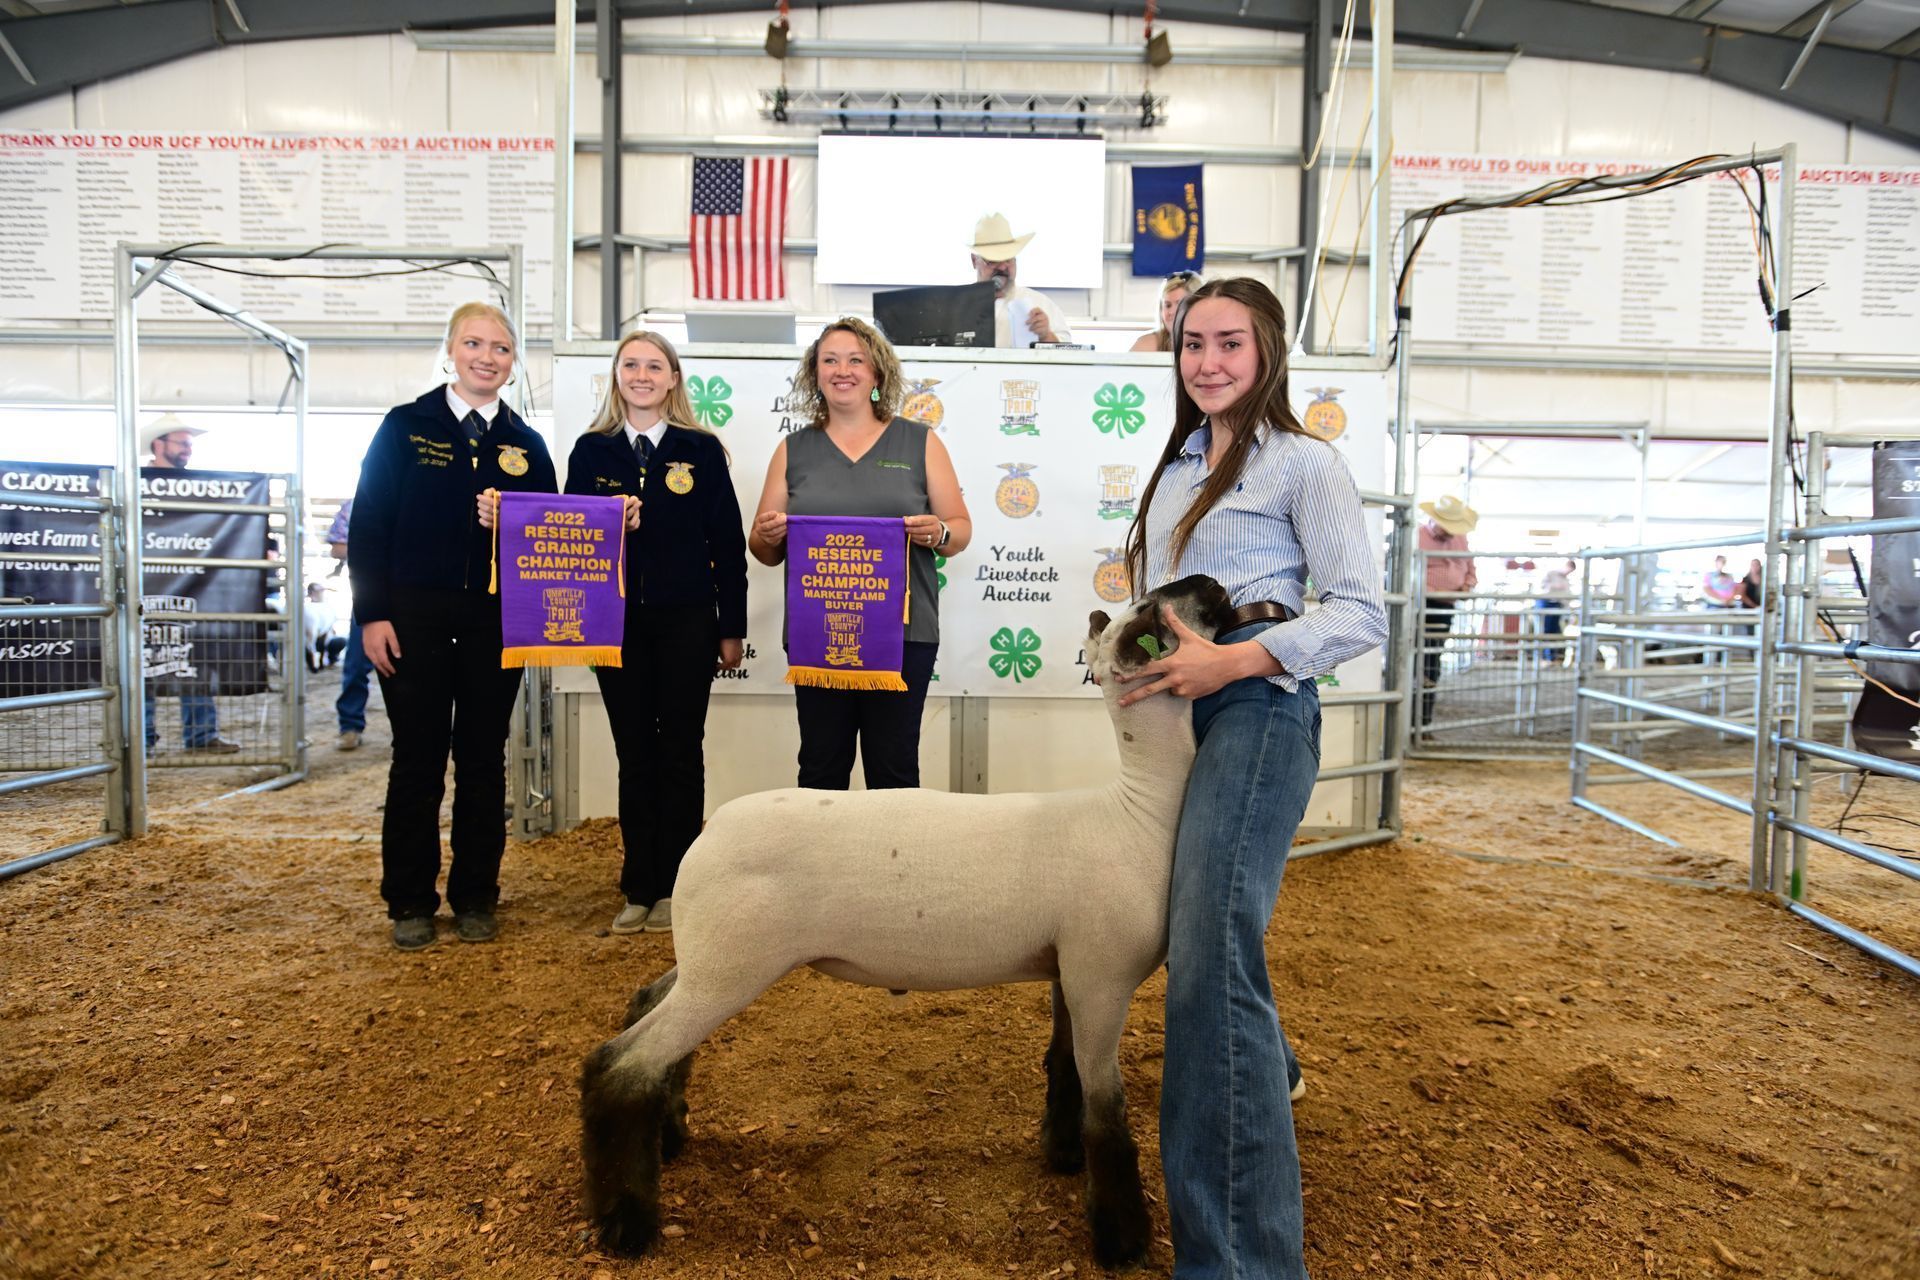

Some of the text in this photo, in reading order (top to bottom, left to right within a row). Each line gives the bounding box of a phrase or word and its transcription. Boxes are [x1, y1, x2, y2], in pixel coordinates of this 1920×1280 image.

[0, 134, 56, 147] THANK
[62, 135, 95, 147] YOU
[102, 135, 123, 147] TO
[129, 136, 163, 148] OUR
[169, 136, 201, 148] UCF
[208, 137, 265, 149] YOUTH
[271, 137, 364, 150] LIVESTOCK
[371, 137, 408, 150] 2021
[416, 138, 492, 150] AUCTION
[1394, 155, 1441, 169] HANK
[1449, 158, 1481, 171] YOU
[1488, 159, 1509, 172] TO
[1515, 159, 1551, 173] OUR
[1556, 160, 1588, 174] UCF
[1800, 170, 1872, 183] AUCTION
[2, 472, 90, 493] CLOTH
[544, 511, 585, 526] 2022
[42, 529, 88, 547] Farm
[145, 532, 212, 550] Services
[524, 525, 605, 541] RESERVE
[825, 534, 865, 547] 2022
[533, 541, 596, 556] GRAND
[808, 547, 883, 562] RESERVE
[991, 545, 1045, 562] Youth
[516, 555, 612, 571] CHAMPION
[815, 562, 874, 575] GRAND
[519, 570, 608, 582] MARKET LAMB
[975, 565, 1060, 582] Livestock
[801, 575, 889, 590] CHAMPION
[804, 589, 886, 601] MARKET LAMB
[982, 585, 1052, 602] Auction
[825, 600, 864, 611] BUYER
[551, 607, 577, 621] FAIR
[831, 632, 855, 646] FAIR
